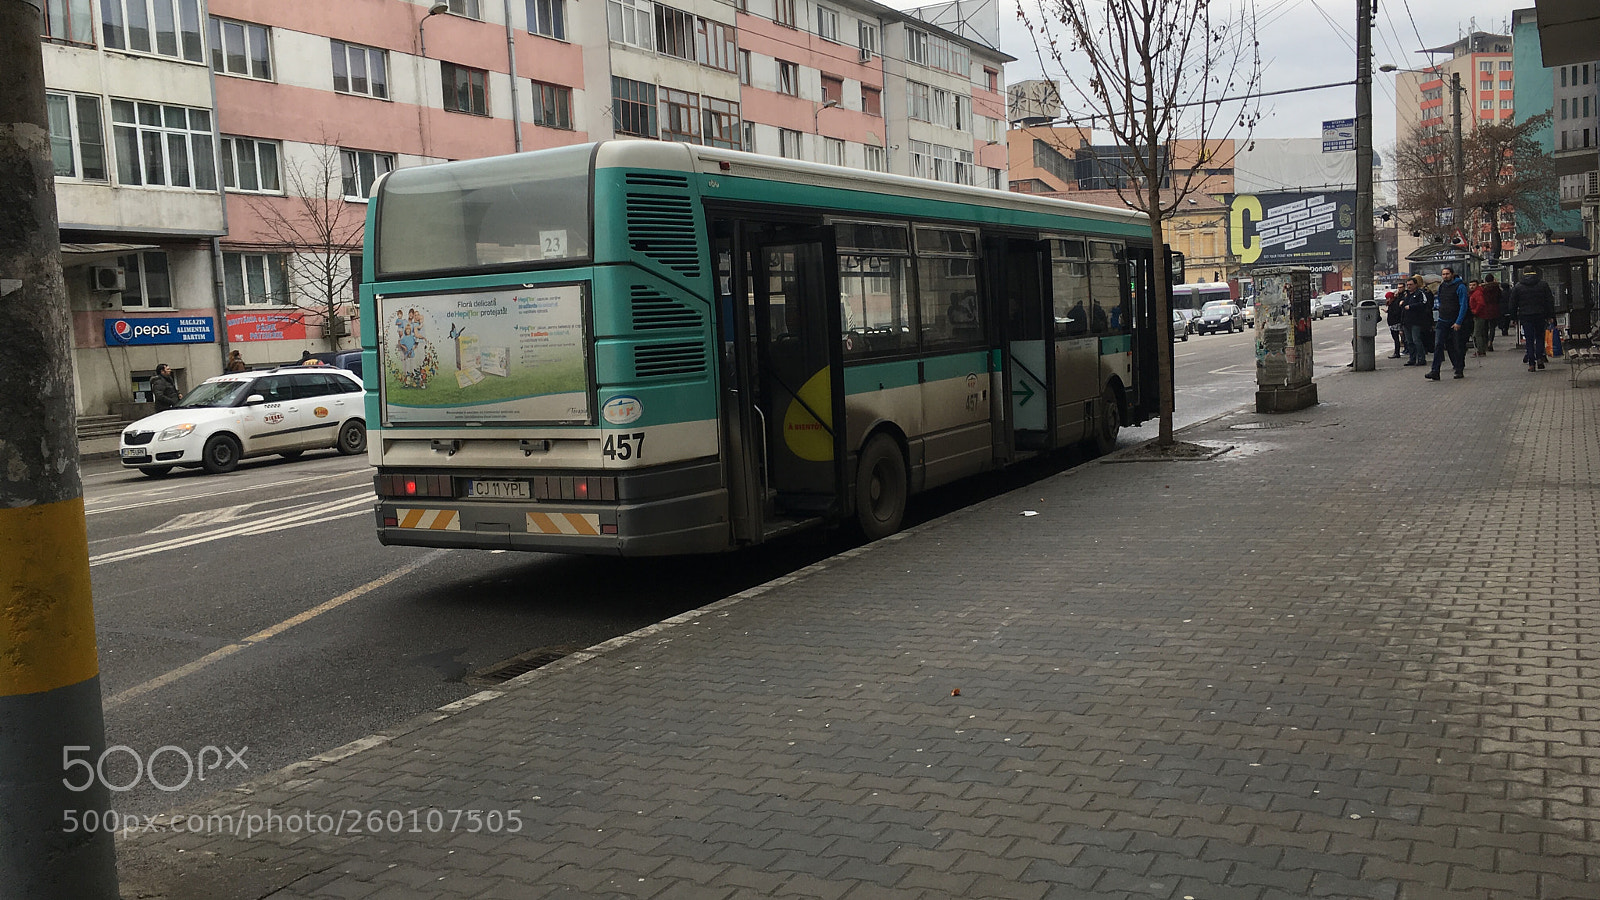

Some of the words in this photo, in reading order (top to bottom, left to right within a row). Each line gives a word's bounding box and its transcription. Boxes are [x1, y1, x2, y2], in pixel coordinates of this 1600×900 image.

[545, 237, 560, 252] 23
[134, 322, 171, 338] pepsi
[603, 432, 645, 461] 457
[476, 482, 490, 496] CJ
[492, 482, 500, 496] 11
[502, 482, 526, 496] YPL
